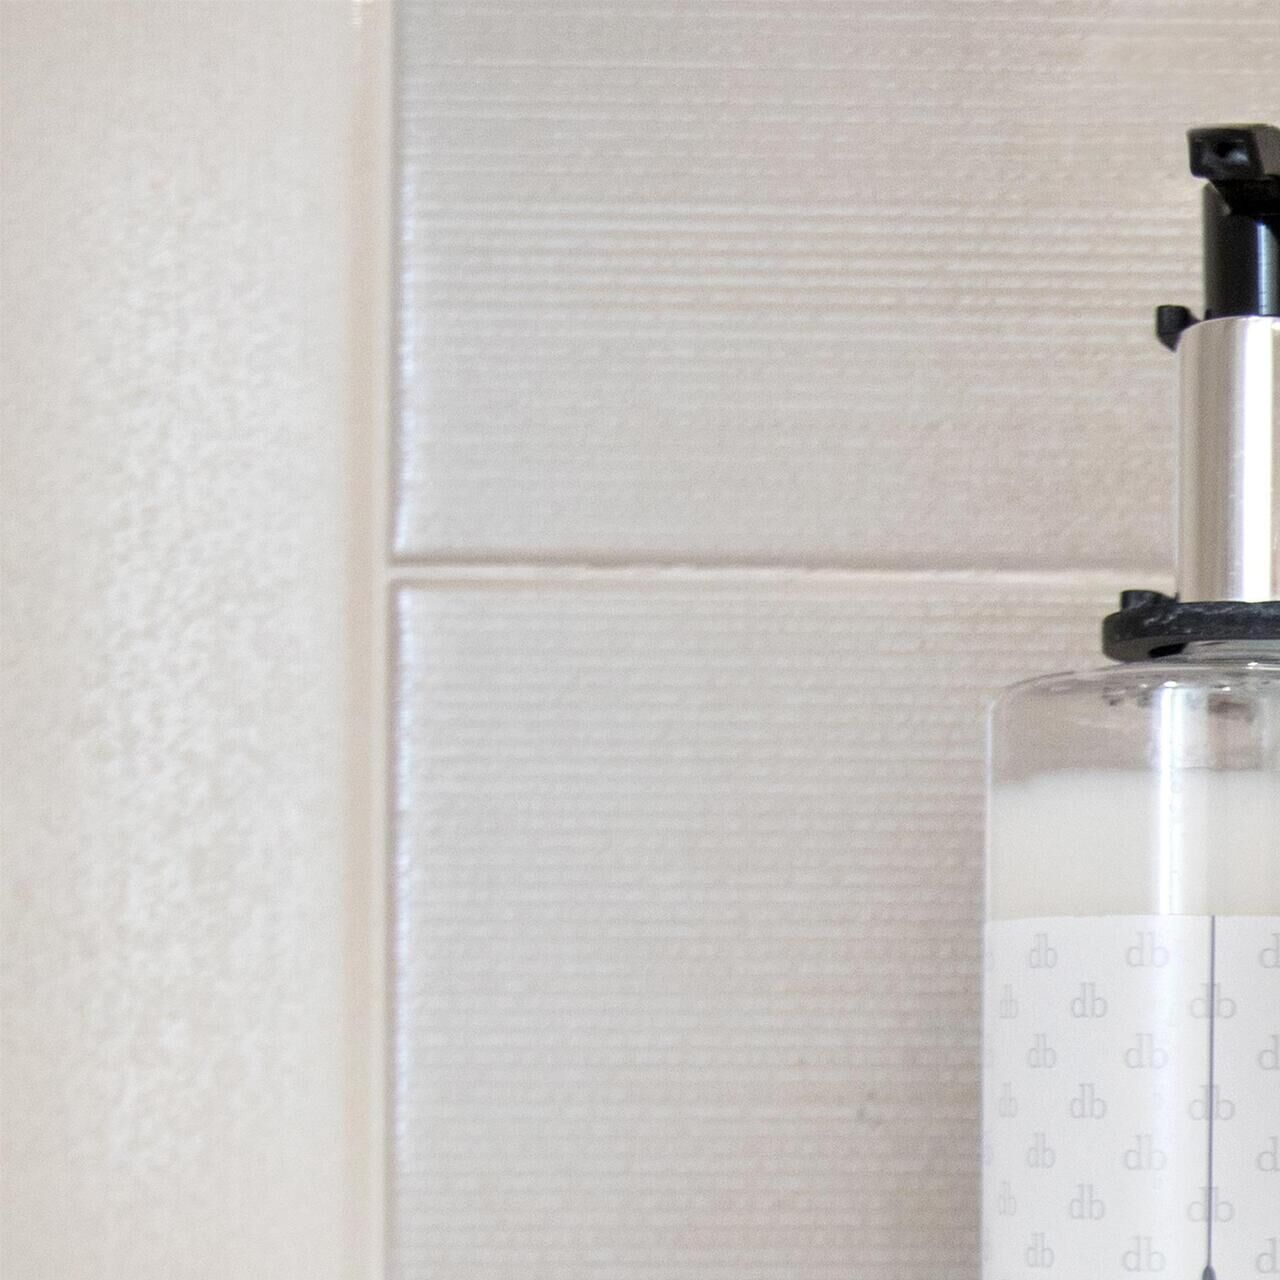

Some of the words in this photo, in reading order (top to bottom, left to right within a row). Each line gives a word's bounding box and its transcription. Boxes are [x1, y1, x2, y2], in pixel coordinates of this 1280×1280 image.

[1028, 934, 1057, 969] db
[1070, 983, 1108, 1018] db
[1069, 1083, 1107, 1119] db
